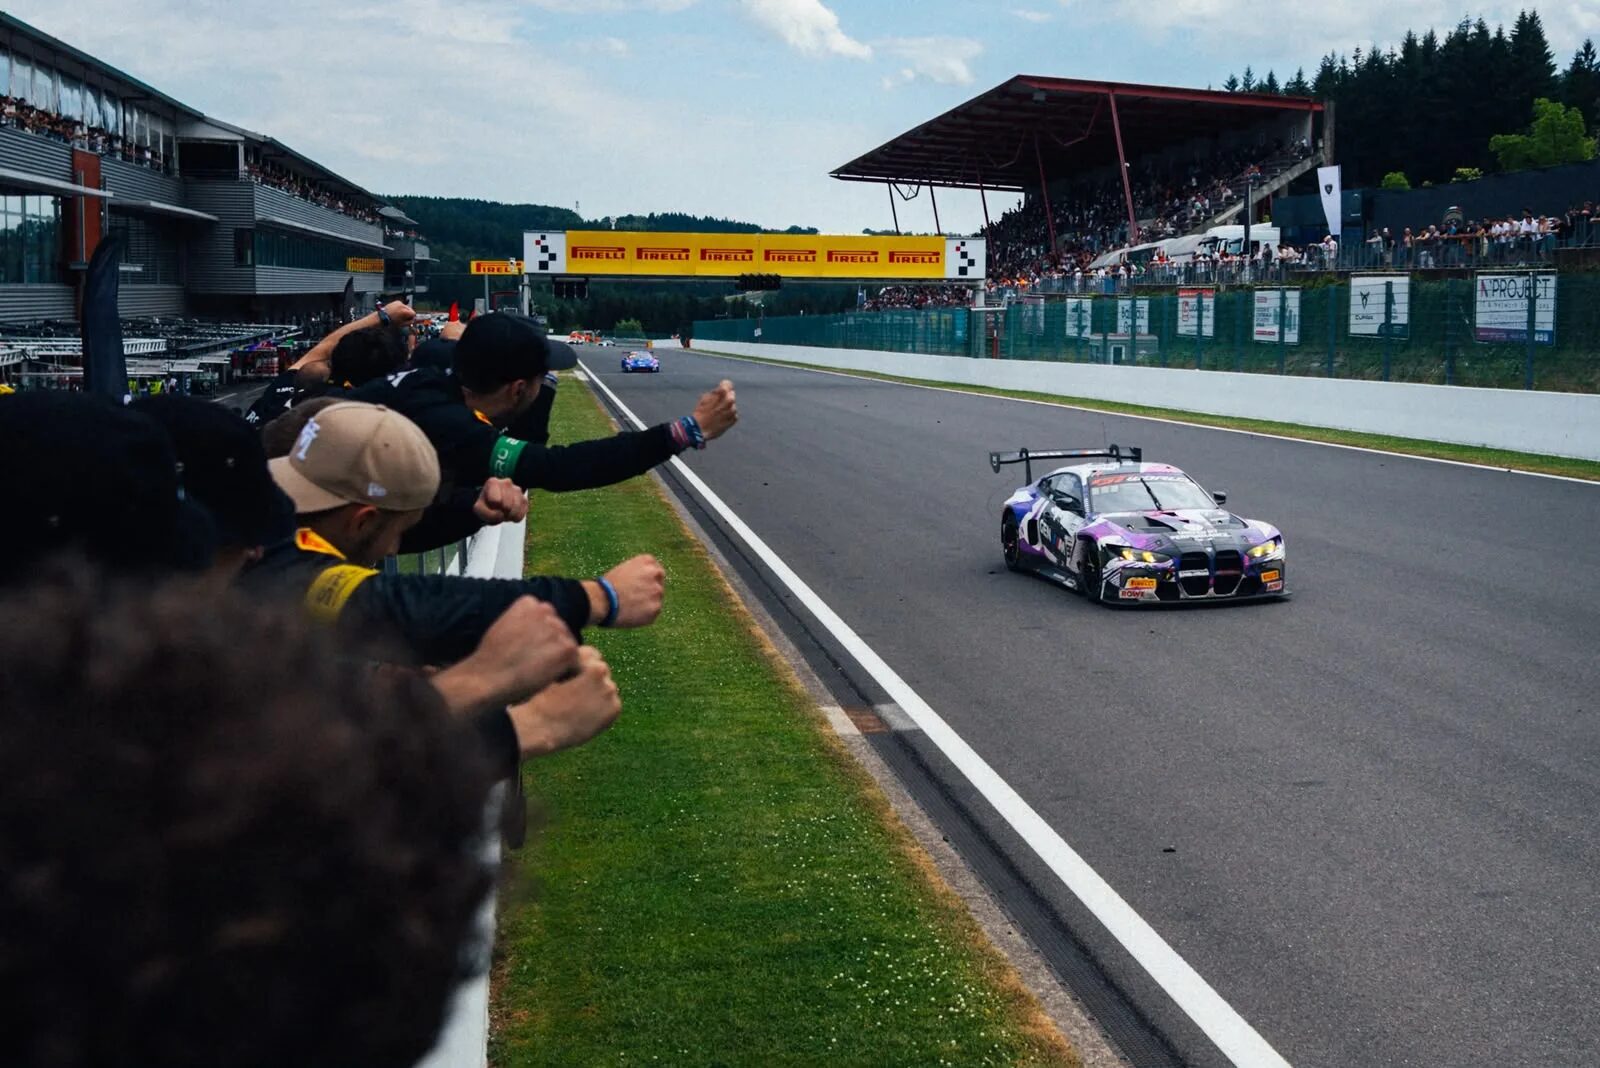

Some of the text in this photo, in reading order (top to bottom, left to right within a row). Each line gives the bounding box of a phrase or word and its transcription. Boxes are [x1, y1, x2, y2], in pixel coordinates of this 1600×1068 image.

[571, 246, 626, 260] PIRELLI
[636, 247, 691, 261] PIRELLI
[700, 248, 754, 262] PIRELLI
[764, 249, 817, 263] PIRELLI
[827, 250, 880, 264] PIRELLI
[888, 251, 941, 264] PIRELLI
[475, 262, 522, 273] PIREL
